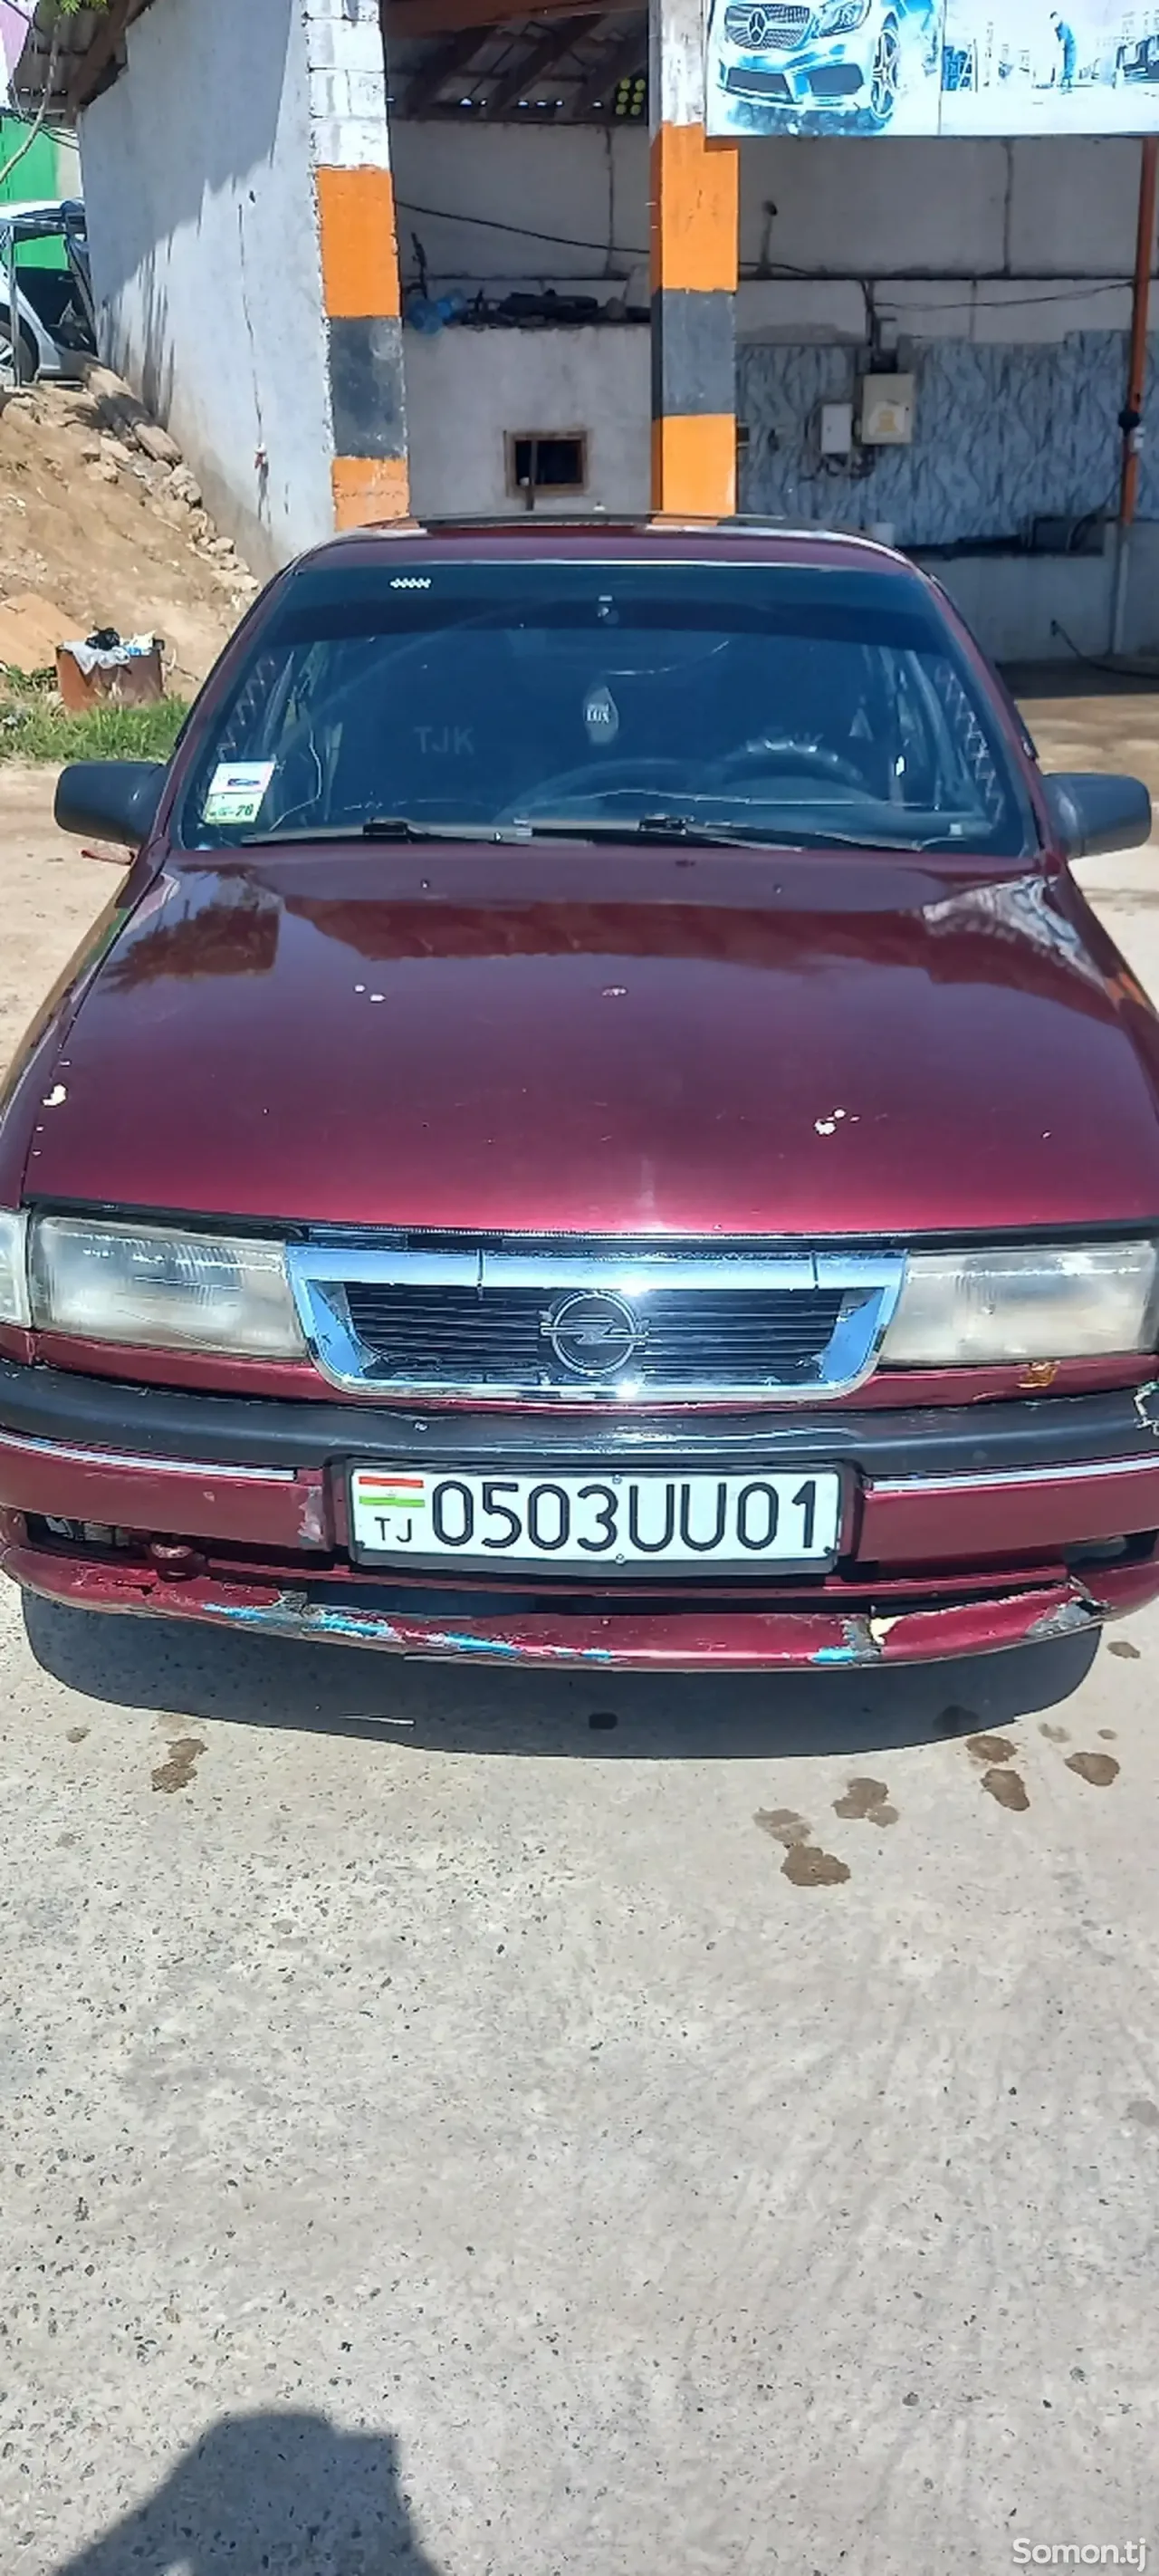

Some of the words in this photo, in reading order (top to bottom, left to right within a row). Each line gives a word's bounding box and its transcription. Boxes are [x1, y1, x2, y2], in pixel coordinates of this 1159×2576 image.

[413, 726, 474, 755] TJK
[374, 1516, 412, 1543] TJ
[432, 1479, 816, 1552] 0503UU01
